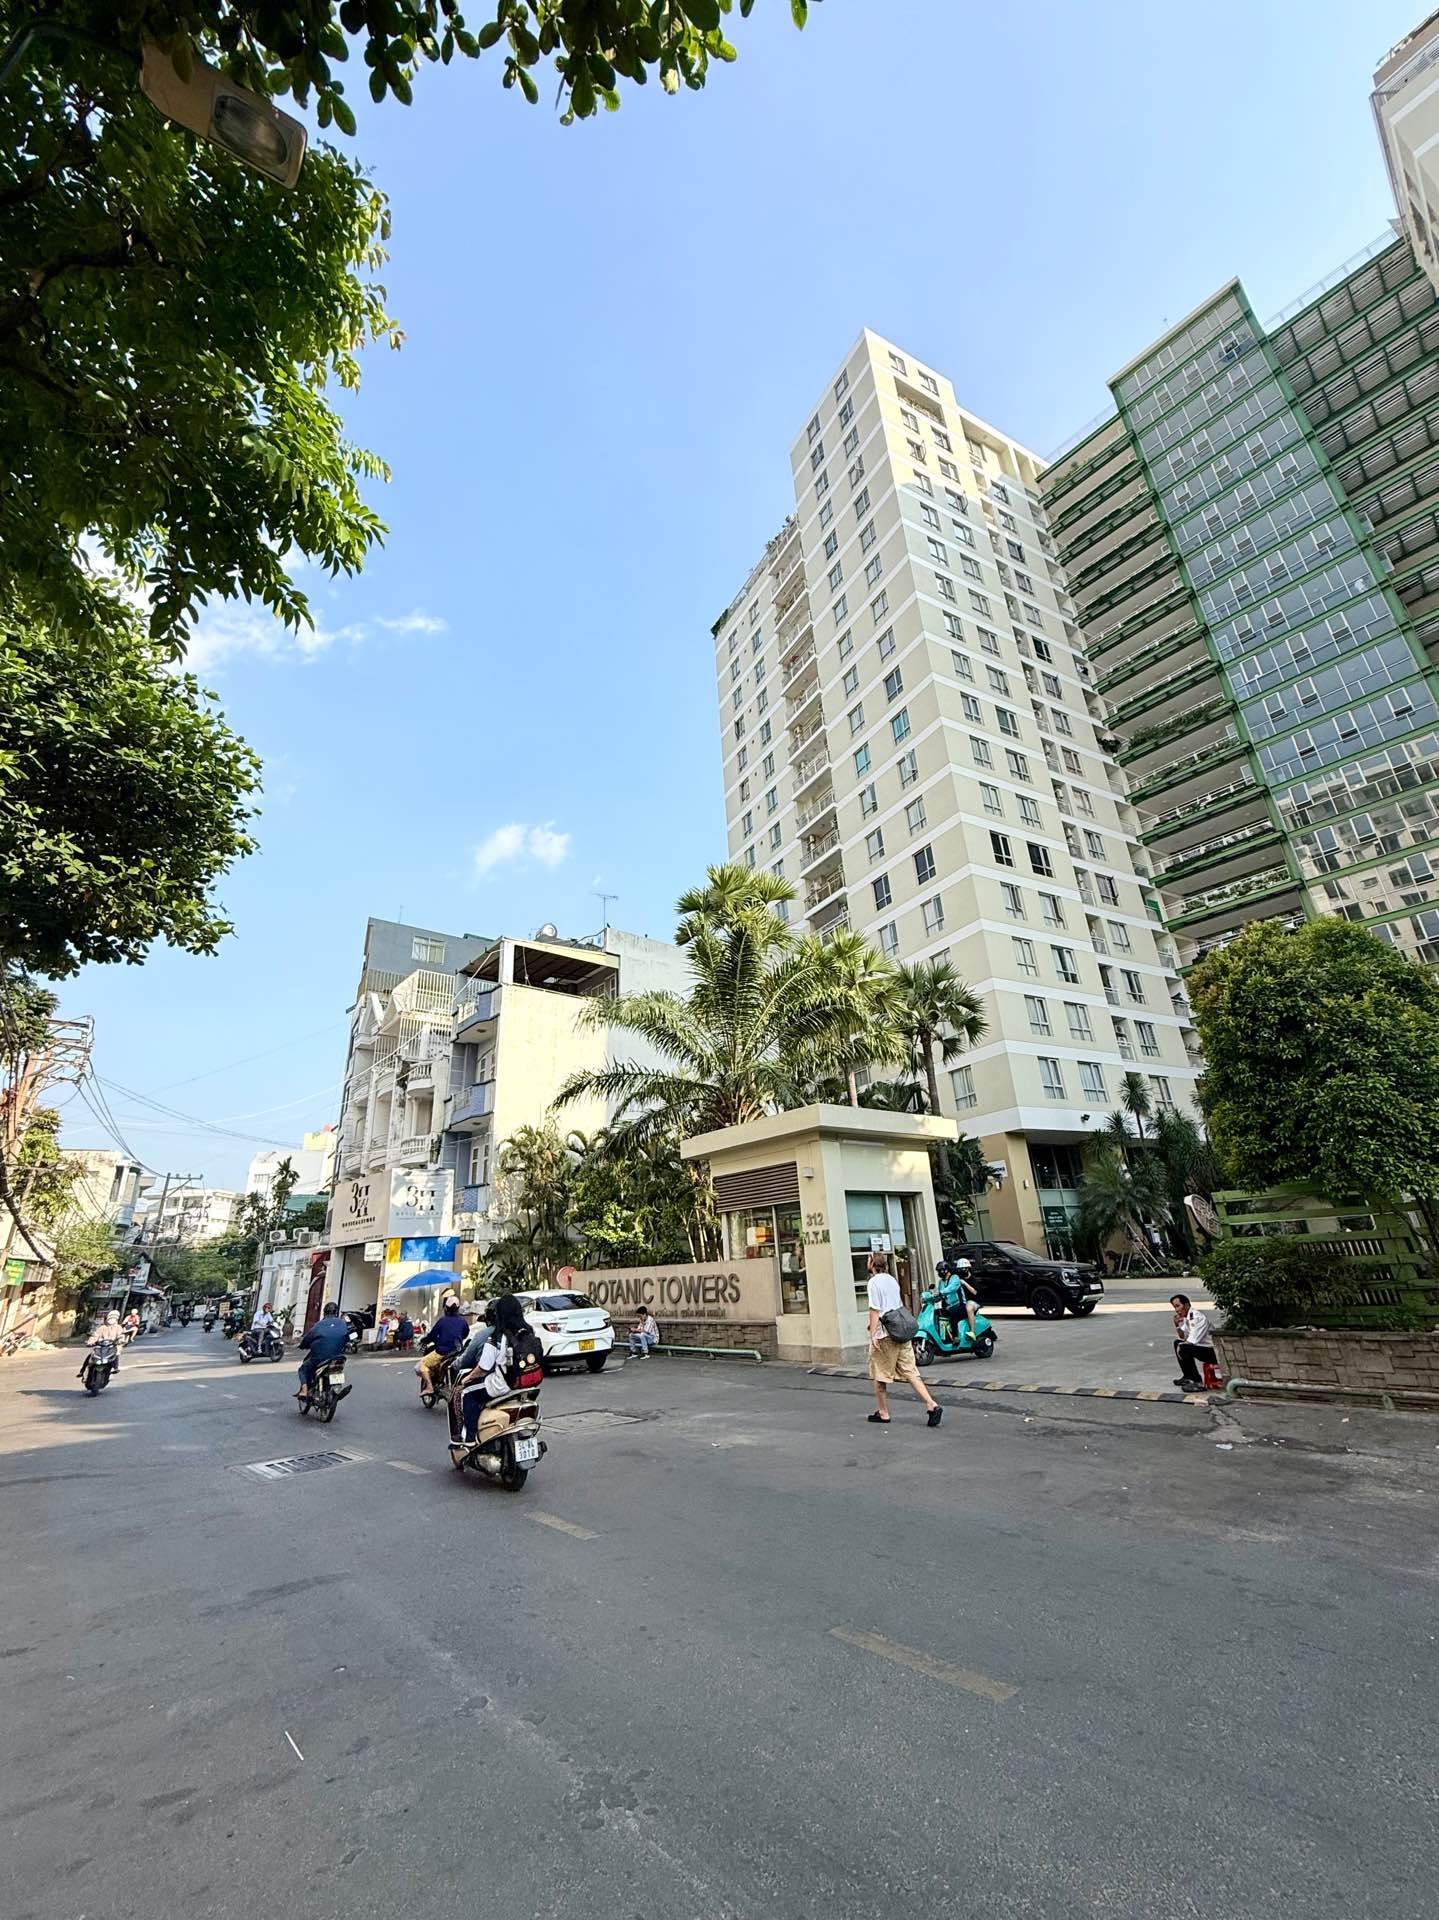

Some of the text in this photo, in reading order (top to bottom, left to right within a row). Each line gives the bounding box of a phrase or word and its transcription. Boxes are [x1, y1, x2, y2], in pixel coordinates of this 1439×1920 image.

[806, 1212, 825, 1227] 312
[588, 1272, 741, 1305] BOTANIC TOWERS
